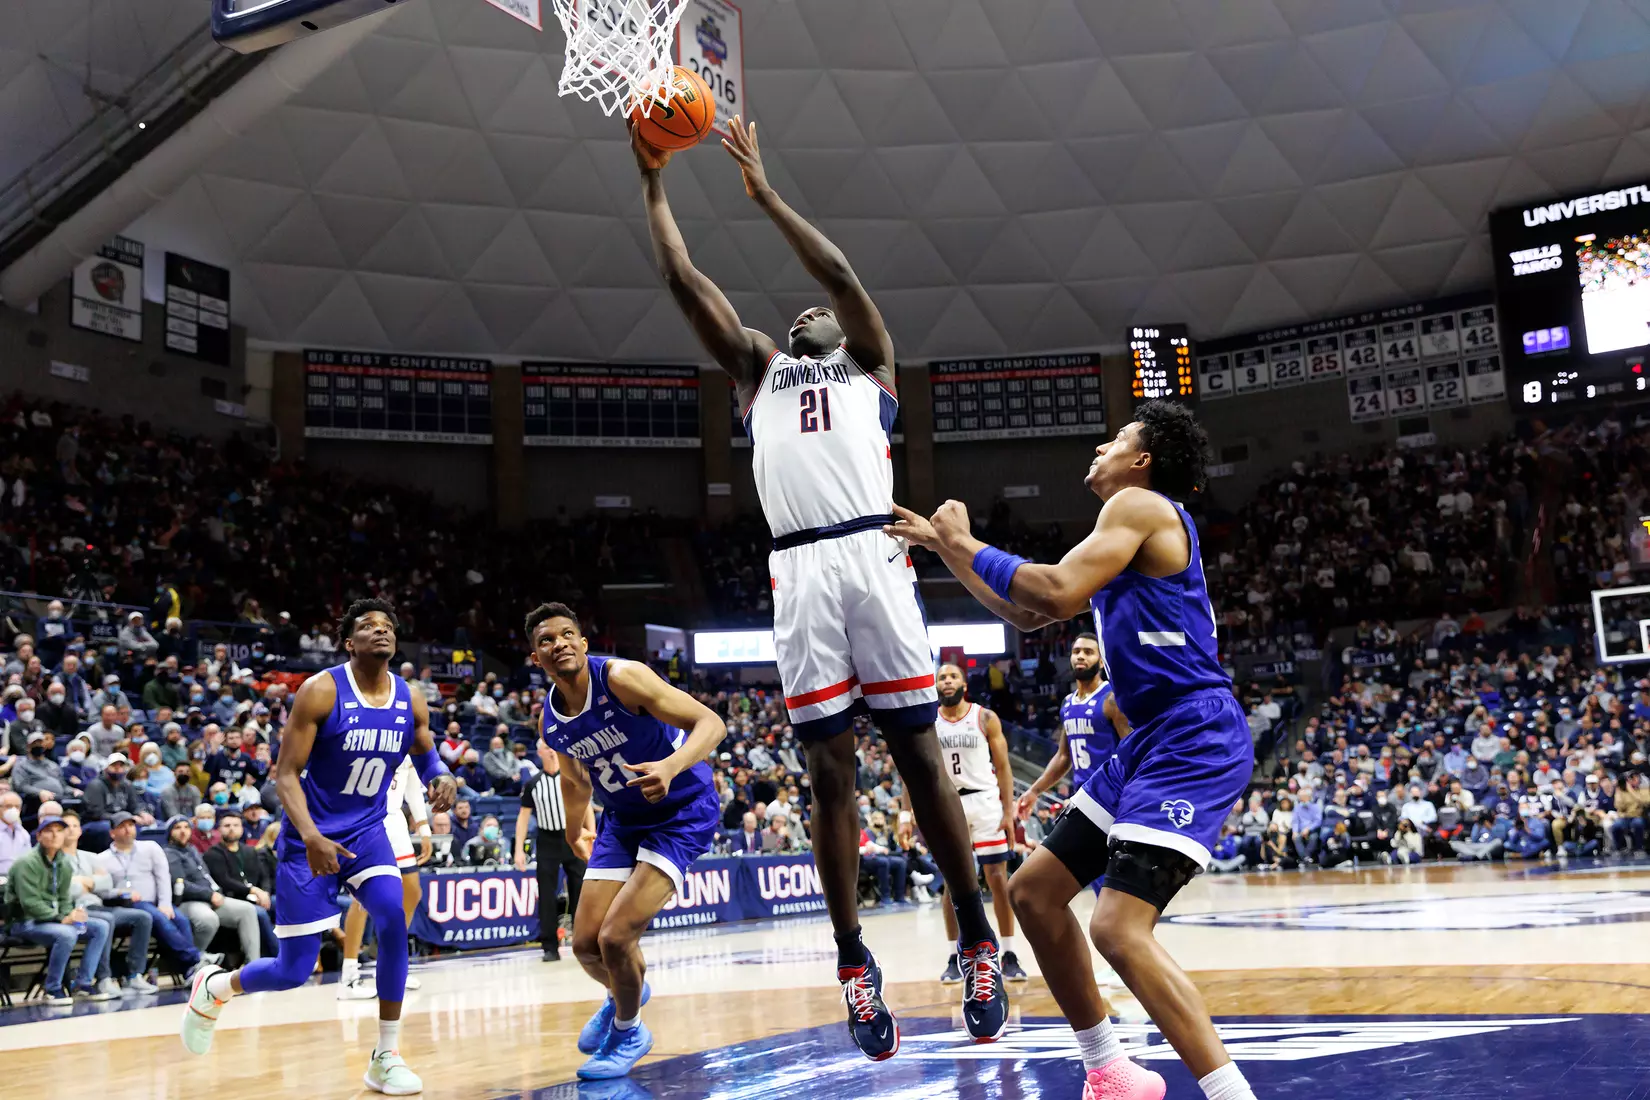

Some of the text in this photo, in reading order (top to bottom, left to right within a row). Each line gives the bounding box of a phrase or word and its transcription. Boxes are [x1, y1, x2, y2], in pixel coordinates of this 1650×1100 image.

[1509, 244, 1562, 264] WELLS
[1512, 257, 1562, 276] FARGO
[1467, 326, 1494, 345] 42
[1523, 326, 1564, 346] CBS
[1350, 347, 1376, 365] 42
[1388, 340, 1414, 358] 44
[342, 354, 381, 366] EAST
[390, 356, 488, 372] CONFERENCE
[938, 356, 1091, 372] NCAA CHAMPIONSHIP
[1276, 360, 1300, 378] 22
[1312, 354, 1338, 372] 25
[1208, 374, 1223, 390] C
[1246, 368, 1256, 383] 9
[1395, 388, 1416, 406] 13
[1432, 381, 1458, 400] 22
[800, 387, 832, 434] 21
[1354, 394, 1380, 412] 24
[1373, 652, 1396, 665] 114
[342, 728, 404, 752] SETON HALL
[592, 724, 628, 751] HALL
[940, 734, 978, 749] NNECTICUT
[952, 752, 962, 774] 2
[1070, 738, 1091, 770] 15
[339, 757, 387, 798] 10
[594, 752, 638, 794] 21
[662, 869, 730, 910] ONN
[757, 864, 824, 900] UCON
[652, 911, 717, 929] BASKETBALL
[442, 925, 530, 942] BASKETBALL
